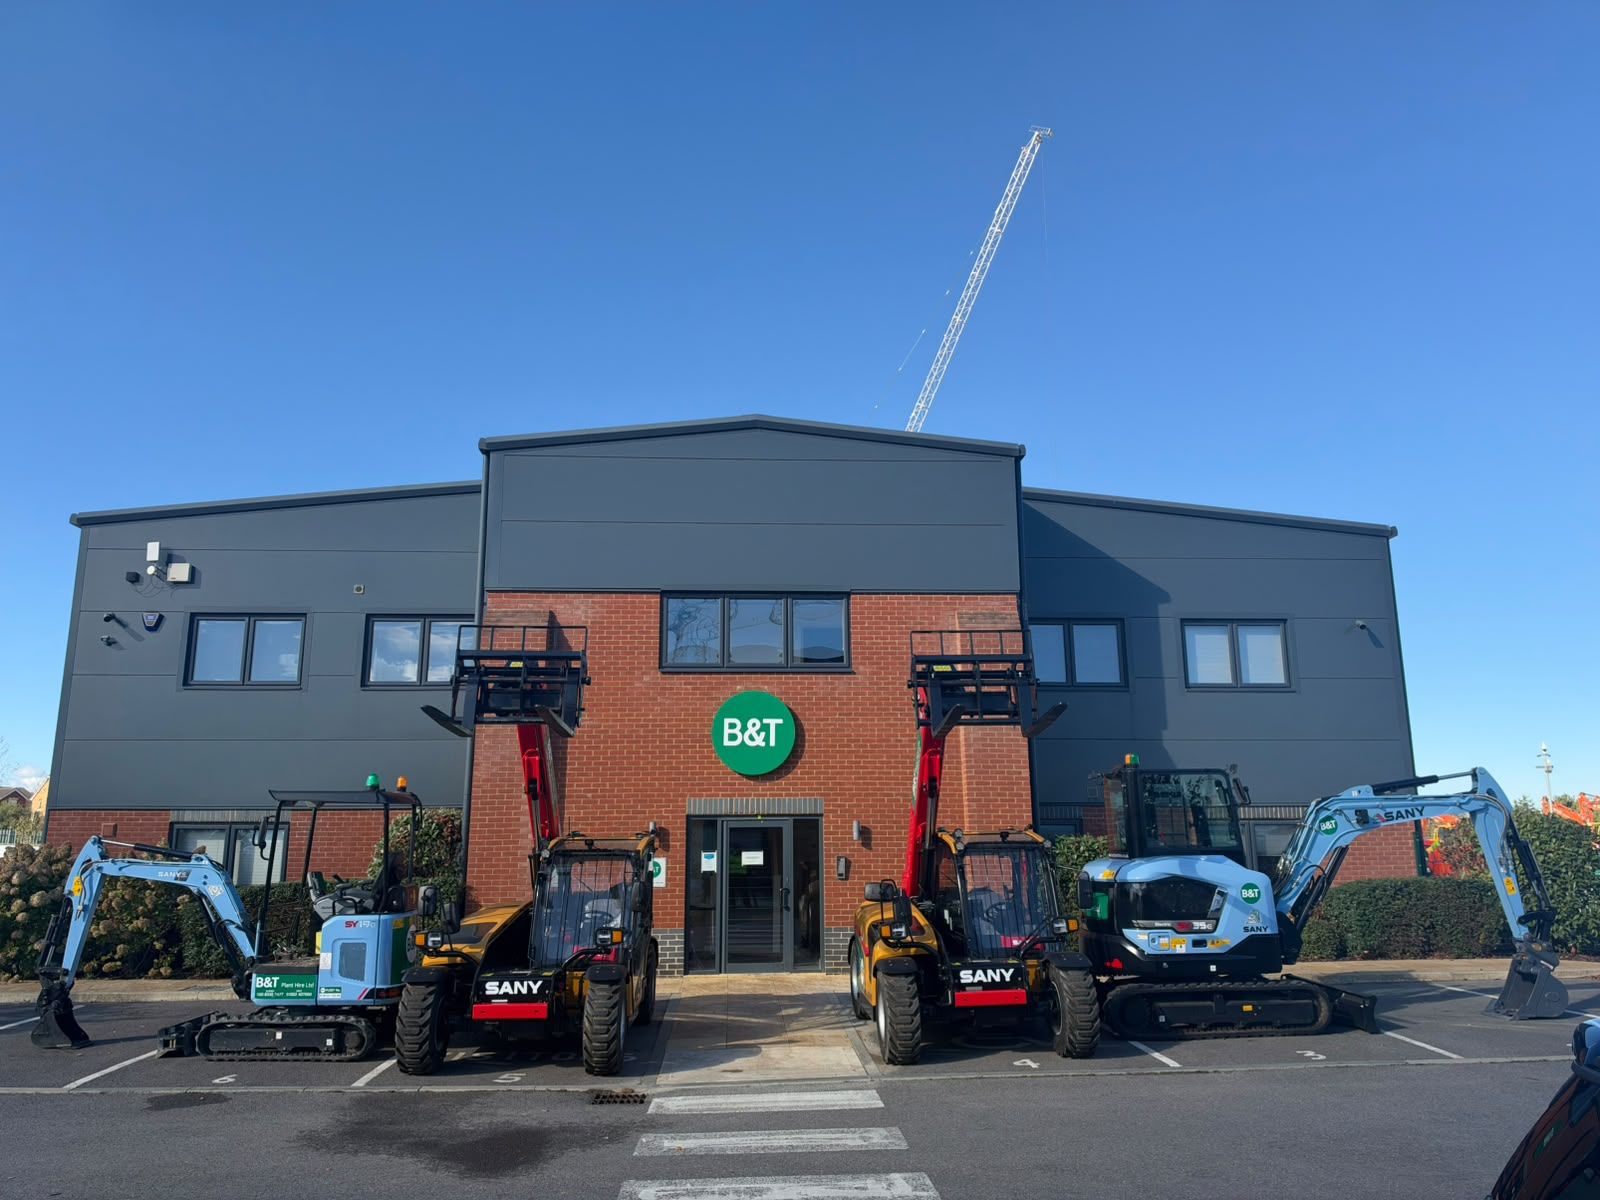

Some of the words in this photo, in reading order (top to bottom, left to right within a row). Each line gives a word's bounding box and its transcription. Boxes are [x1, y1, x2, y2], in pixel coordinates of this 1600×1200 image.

[723, 717, 783, 747] B&T
[1383, 806, 1425, 821] SANY
[1320, 820, 1337, 831] B&T
[1241, 888, 1259, 898] B&T
[960, 968, 1015, 984] SANY
[255, 976, 280, 988] B&T
[485, 981, 544, 996] SANY
[1295, 1050, 1327, 1060] 3
[1013, 1058, 1040, 1069] 4
[211, 1073, 238, 1084] 6
[492, 1072, 527, 1083] 5
